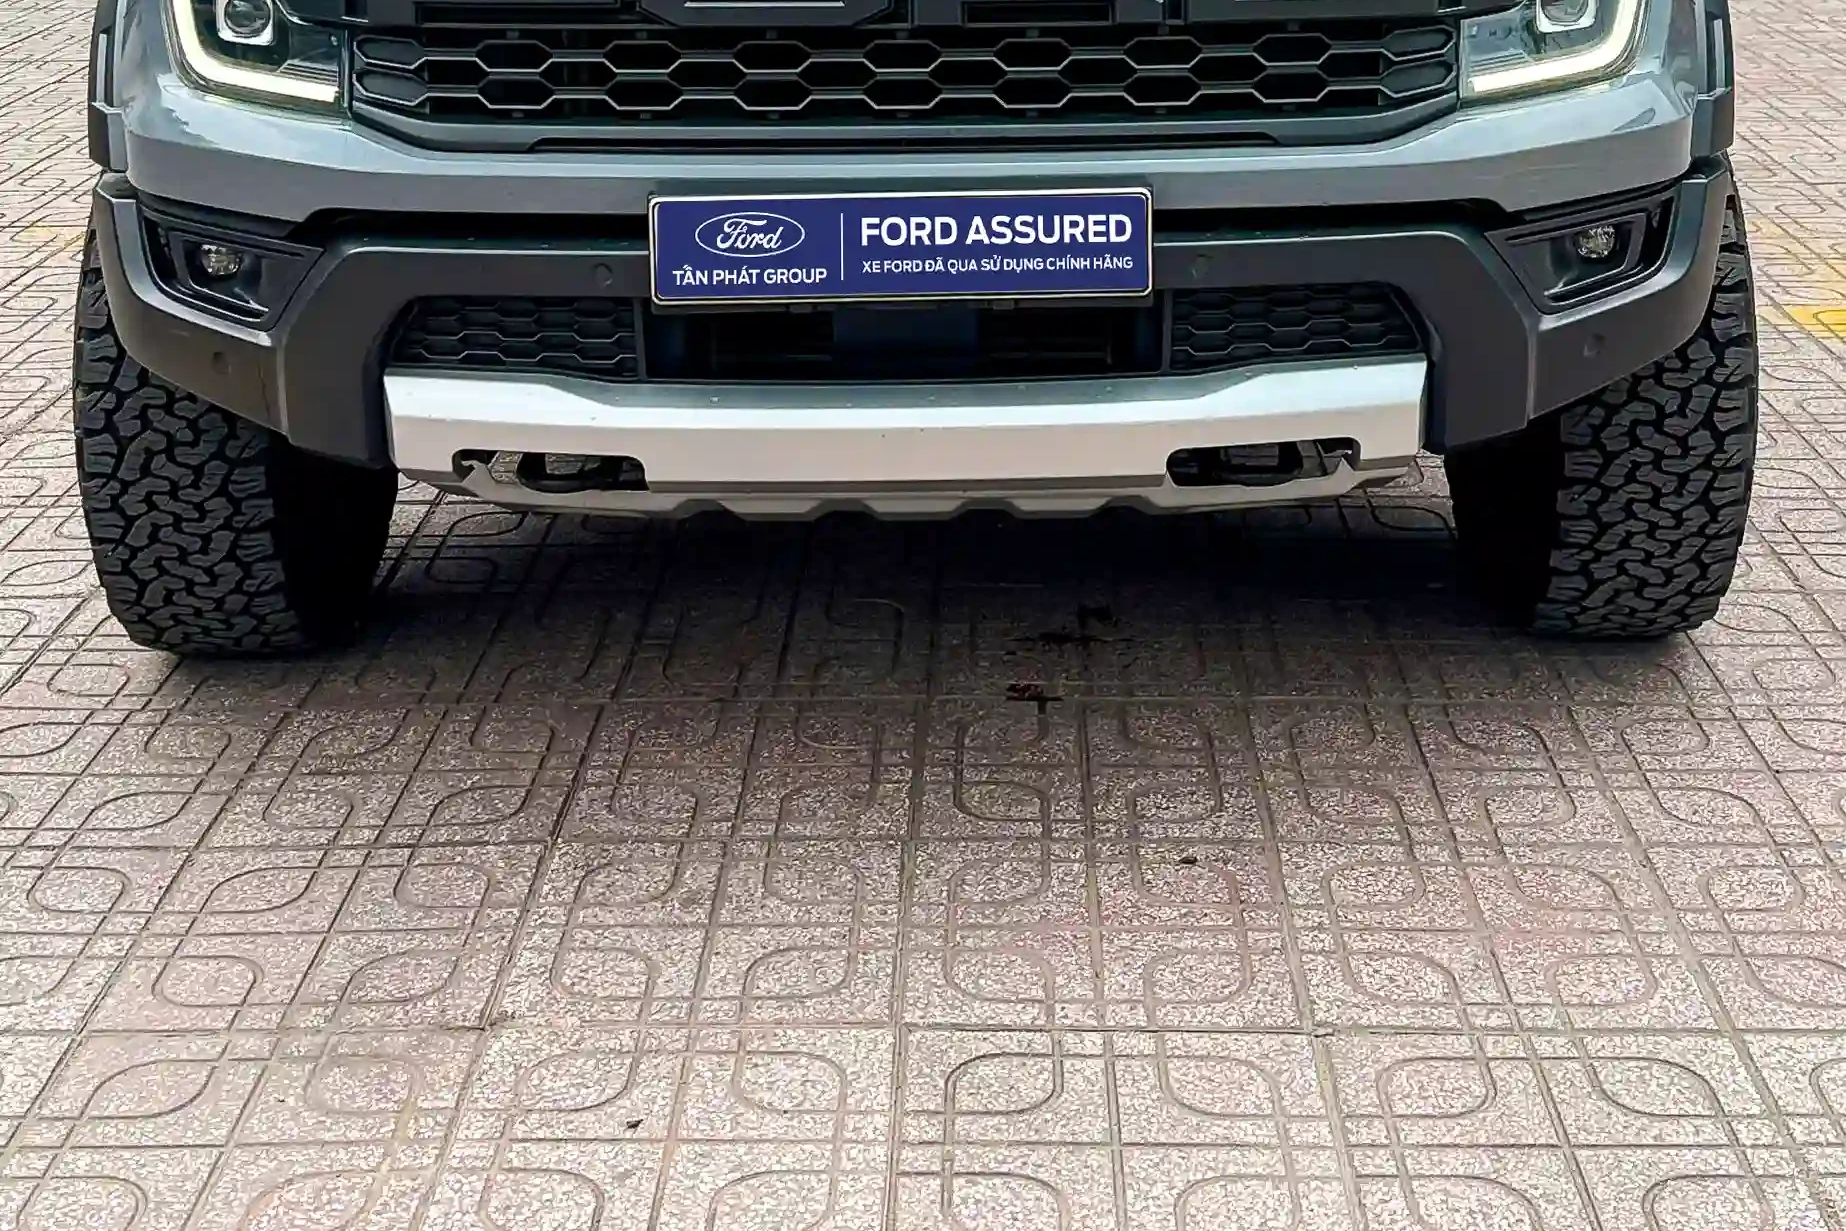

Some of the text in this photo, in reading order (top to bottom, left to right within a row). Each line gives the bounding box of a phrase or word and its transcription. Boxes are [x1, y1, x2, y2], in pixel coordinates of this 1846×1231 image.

[716, 218, 783, 250] Ford
[861, 214, 1133, 247] FORD ASSURED
[712, 265, 760, 285] PHÁT
[763, 268, 827, 285] GROUP
[862, 255, 1133, 274] XE FORD ĐÃ QUA SỬ DỤNG CHÍNH HÃNG
